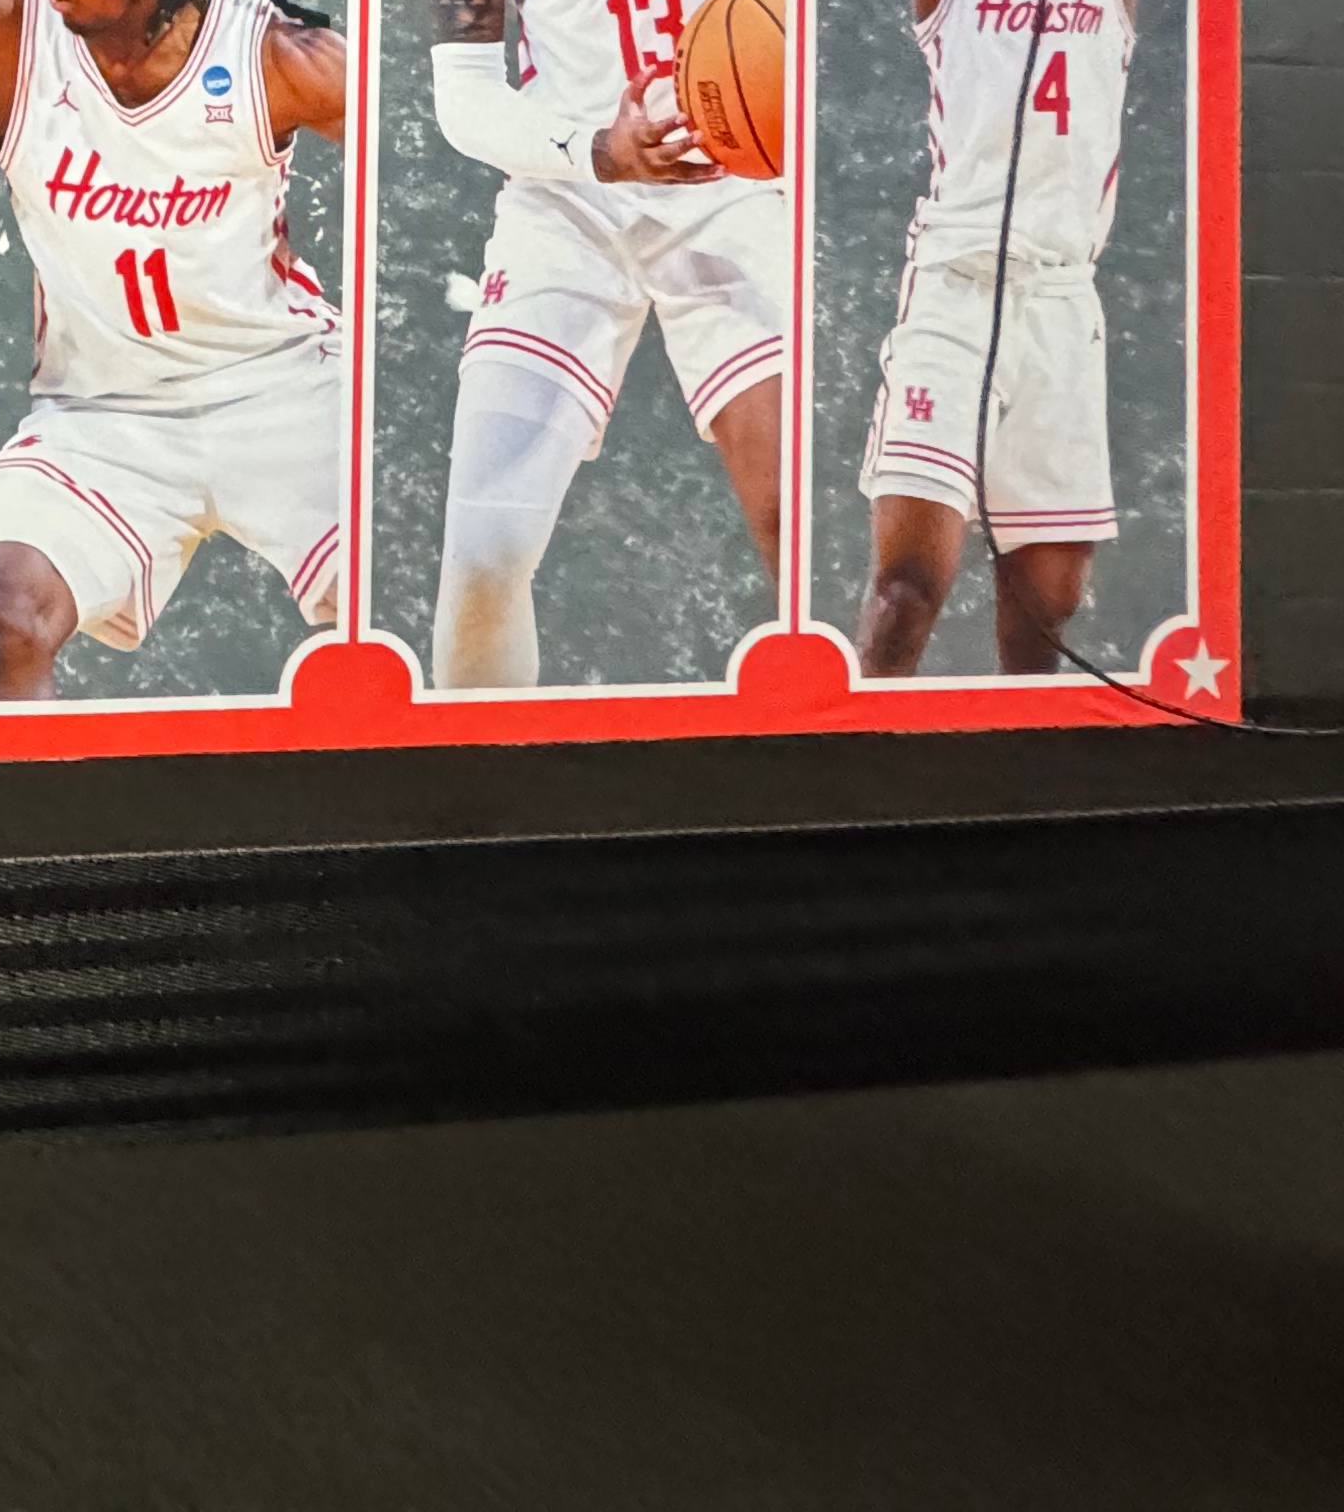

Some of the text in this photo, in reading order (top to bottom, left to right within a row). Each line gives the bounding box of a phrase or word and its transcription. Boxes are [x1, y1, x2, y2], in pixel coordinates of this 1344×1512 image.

[1033, 50, 1070, 136] 4
[45, 146, 232, 230] Houston
[114, 248, 180, 338] 11
